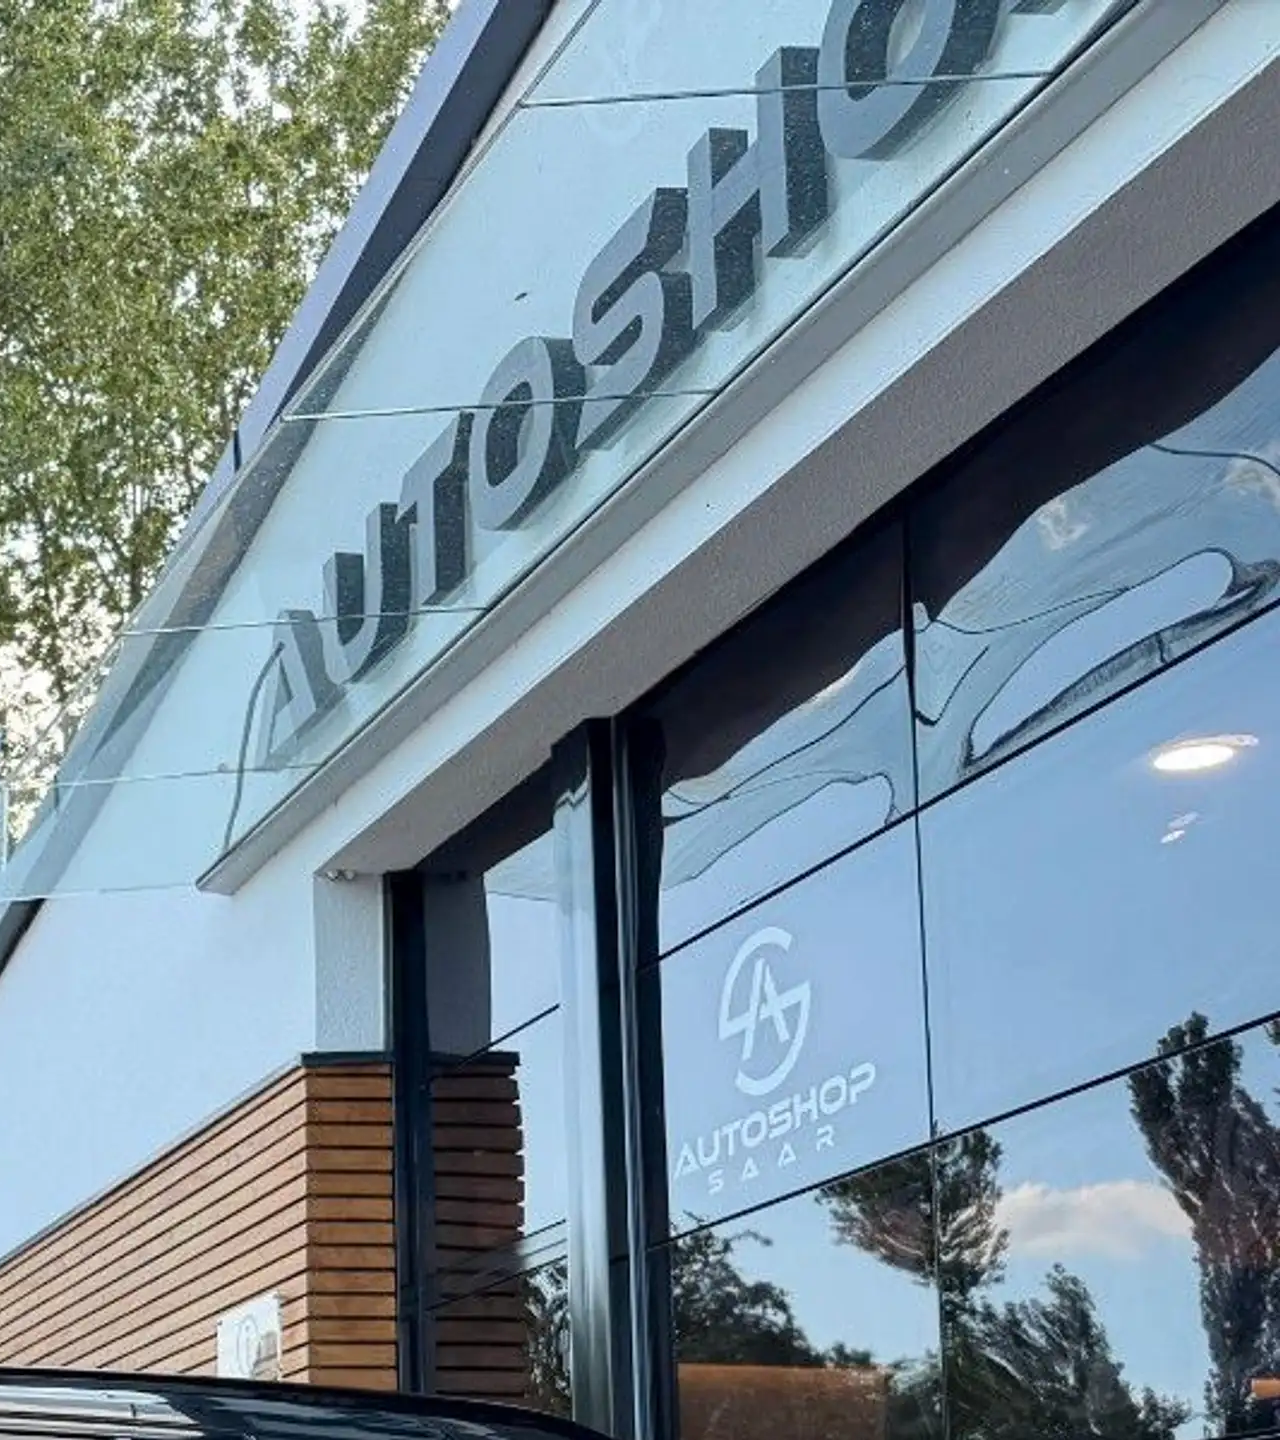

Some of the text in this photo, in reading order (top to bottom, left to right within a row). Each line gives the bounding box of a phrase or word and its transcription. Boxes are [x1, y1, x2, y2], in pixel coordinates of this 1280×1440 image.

[255, 0, 1066, 767] AUTOSHO
[673, 1062, 876, 1180] AUTOSHOP
[707, 1124, 835, 1195] SAAR
